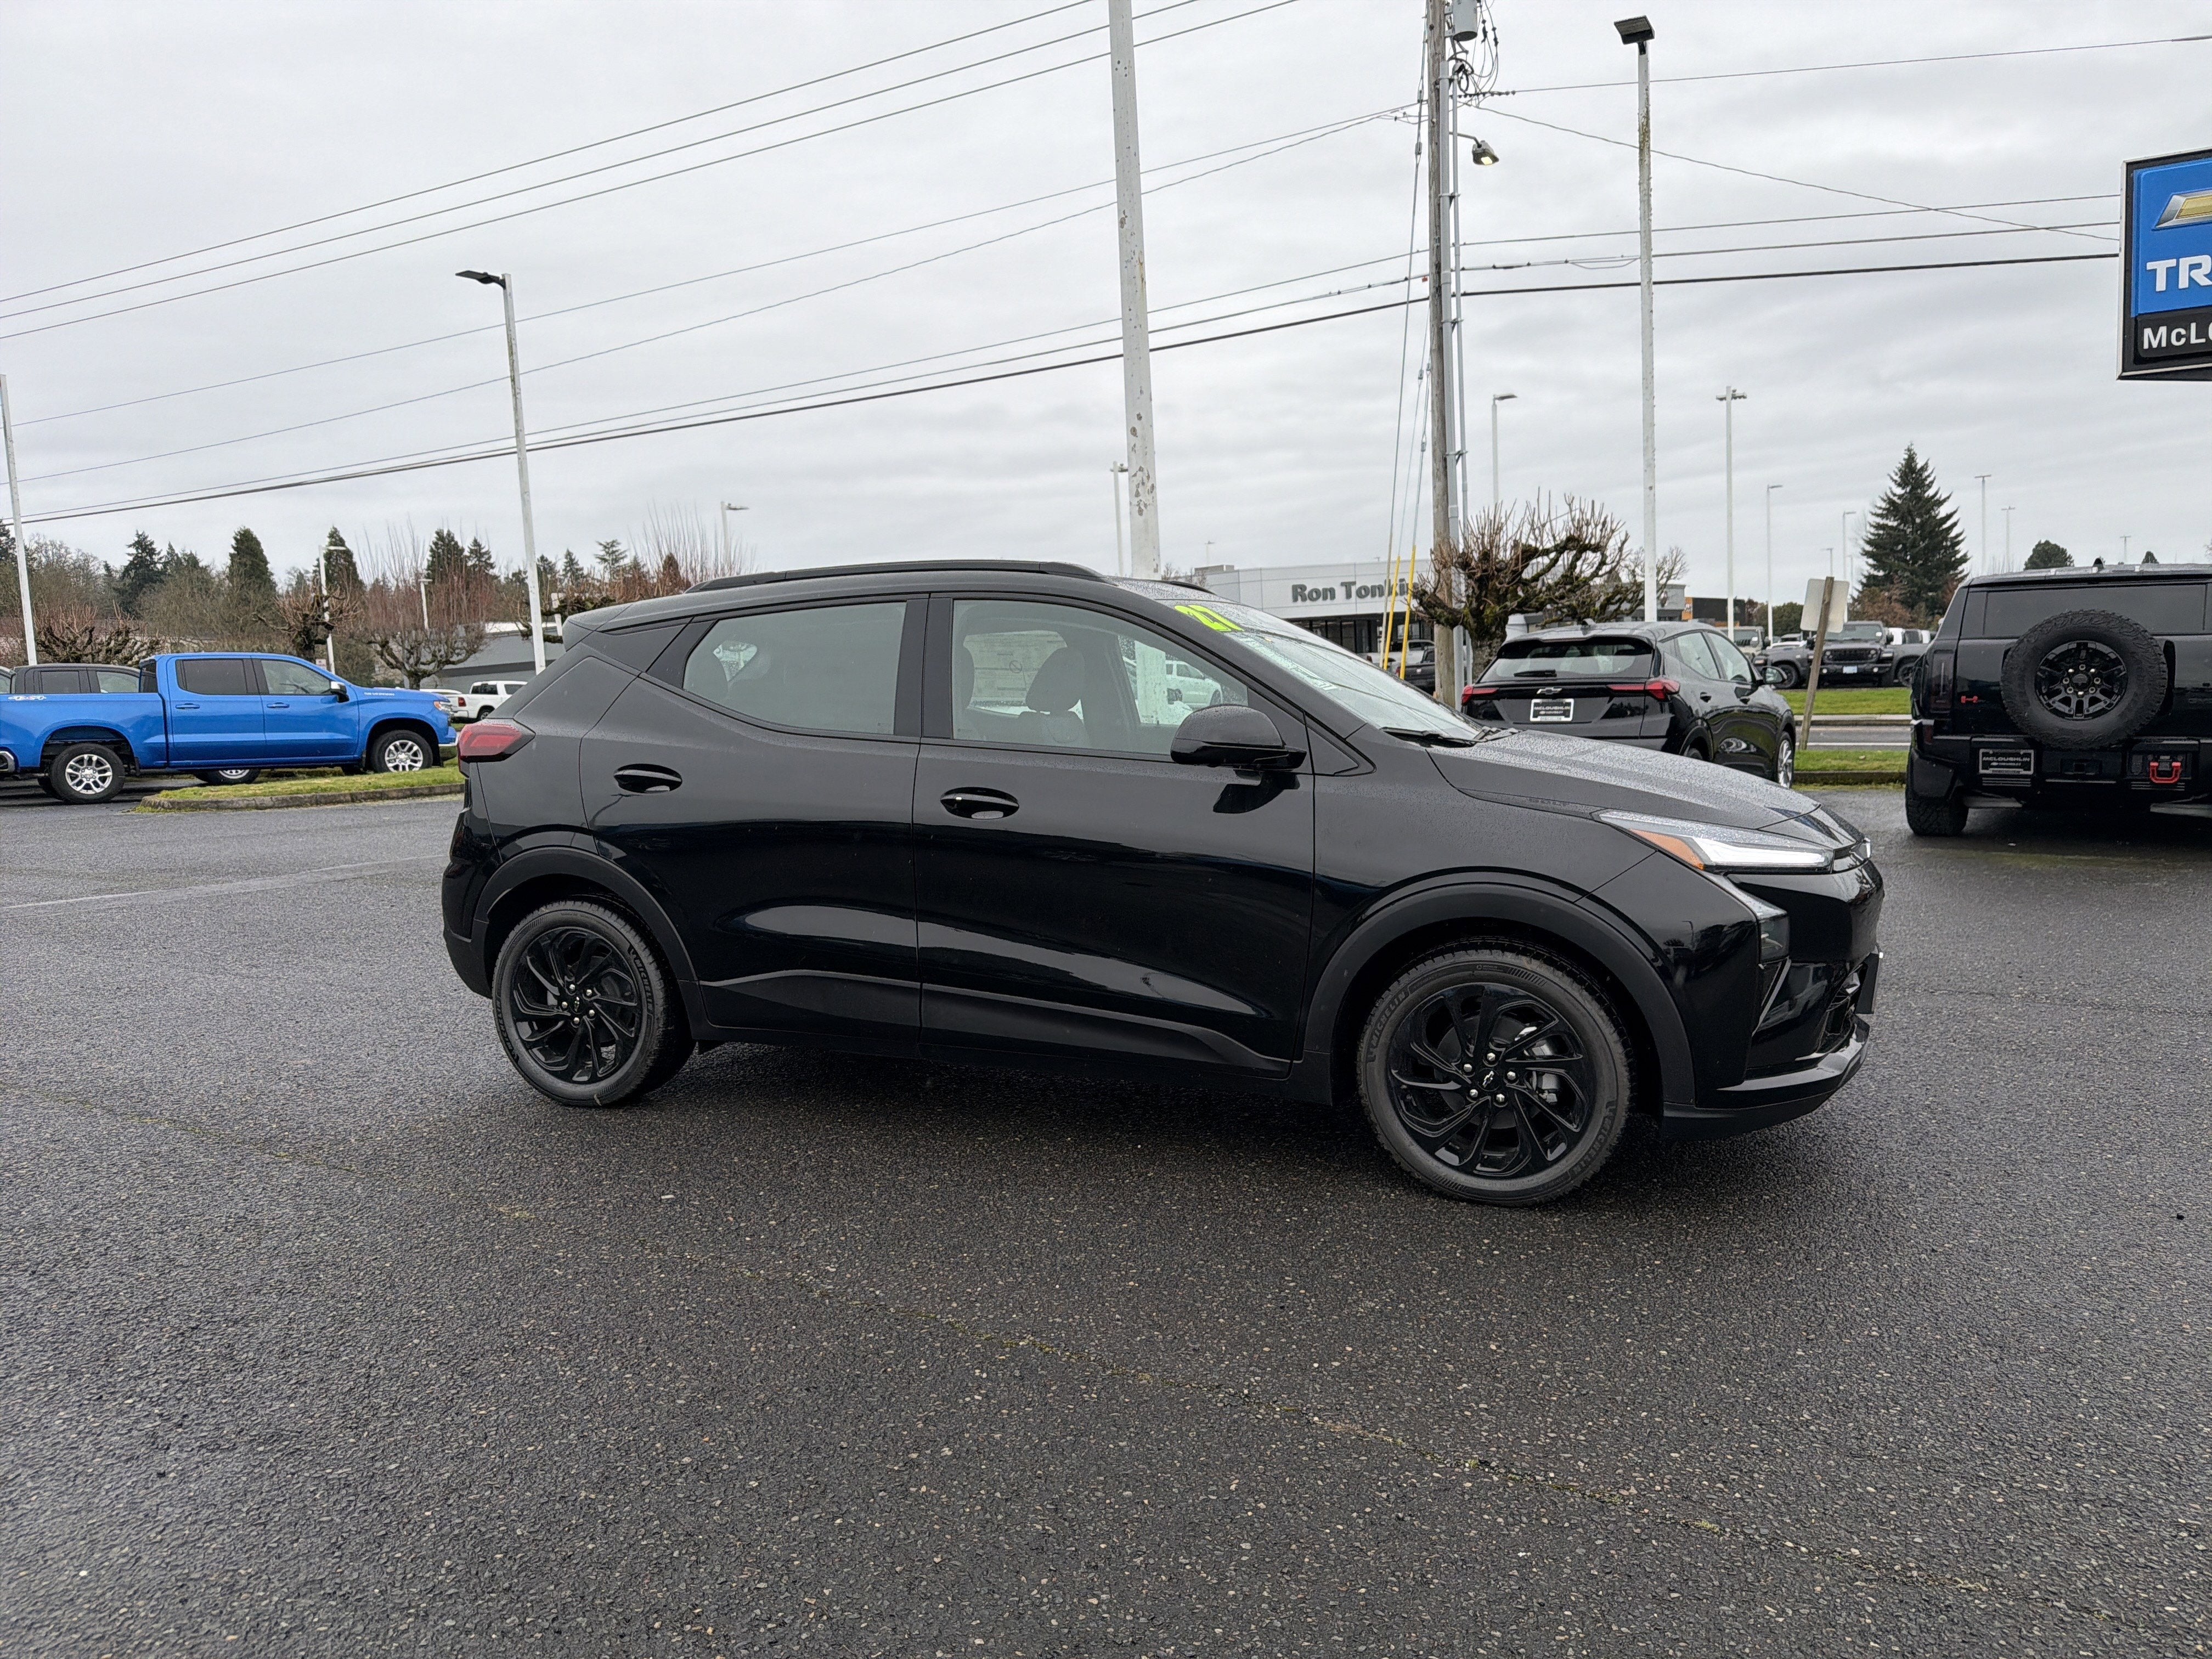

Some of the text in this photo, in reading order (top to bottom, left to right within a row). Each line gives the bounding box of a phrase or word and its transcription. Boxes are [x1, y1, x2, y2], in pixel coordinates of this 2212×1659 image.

[2146, 255, 2212, 292] TR
[1291, 584, 1336, 602] Ron
[635, 958, 653, 1011] MICHELIN
[1370, 991, 1406, 1047] MICHELIN
